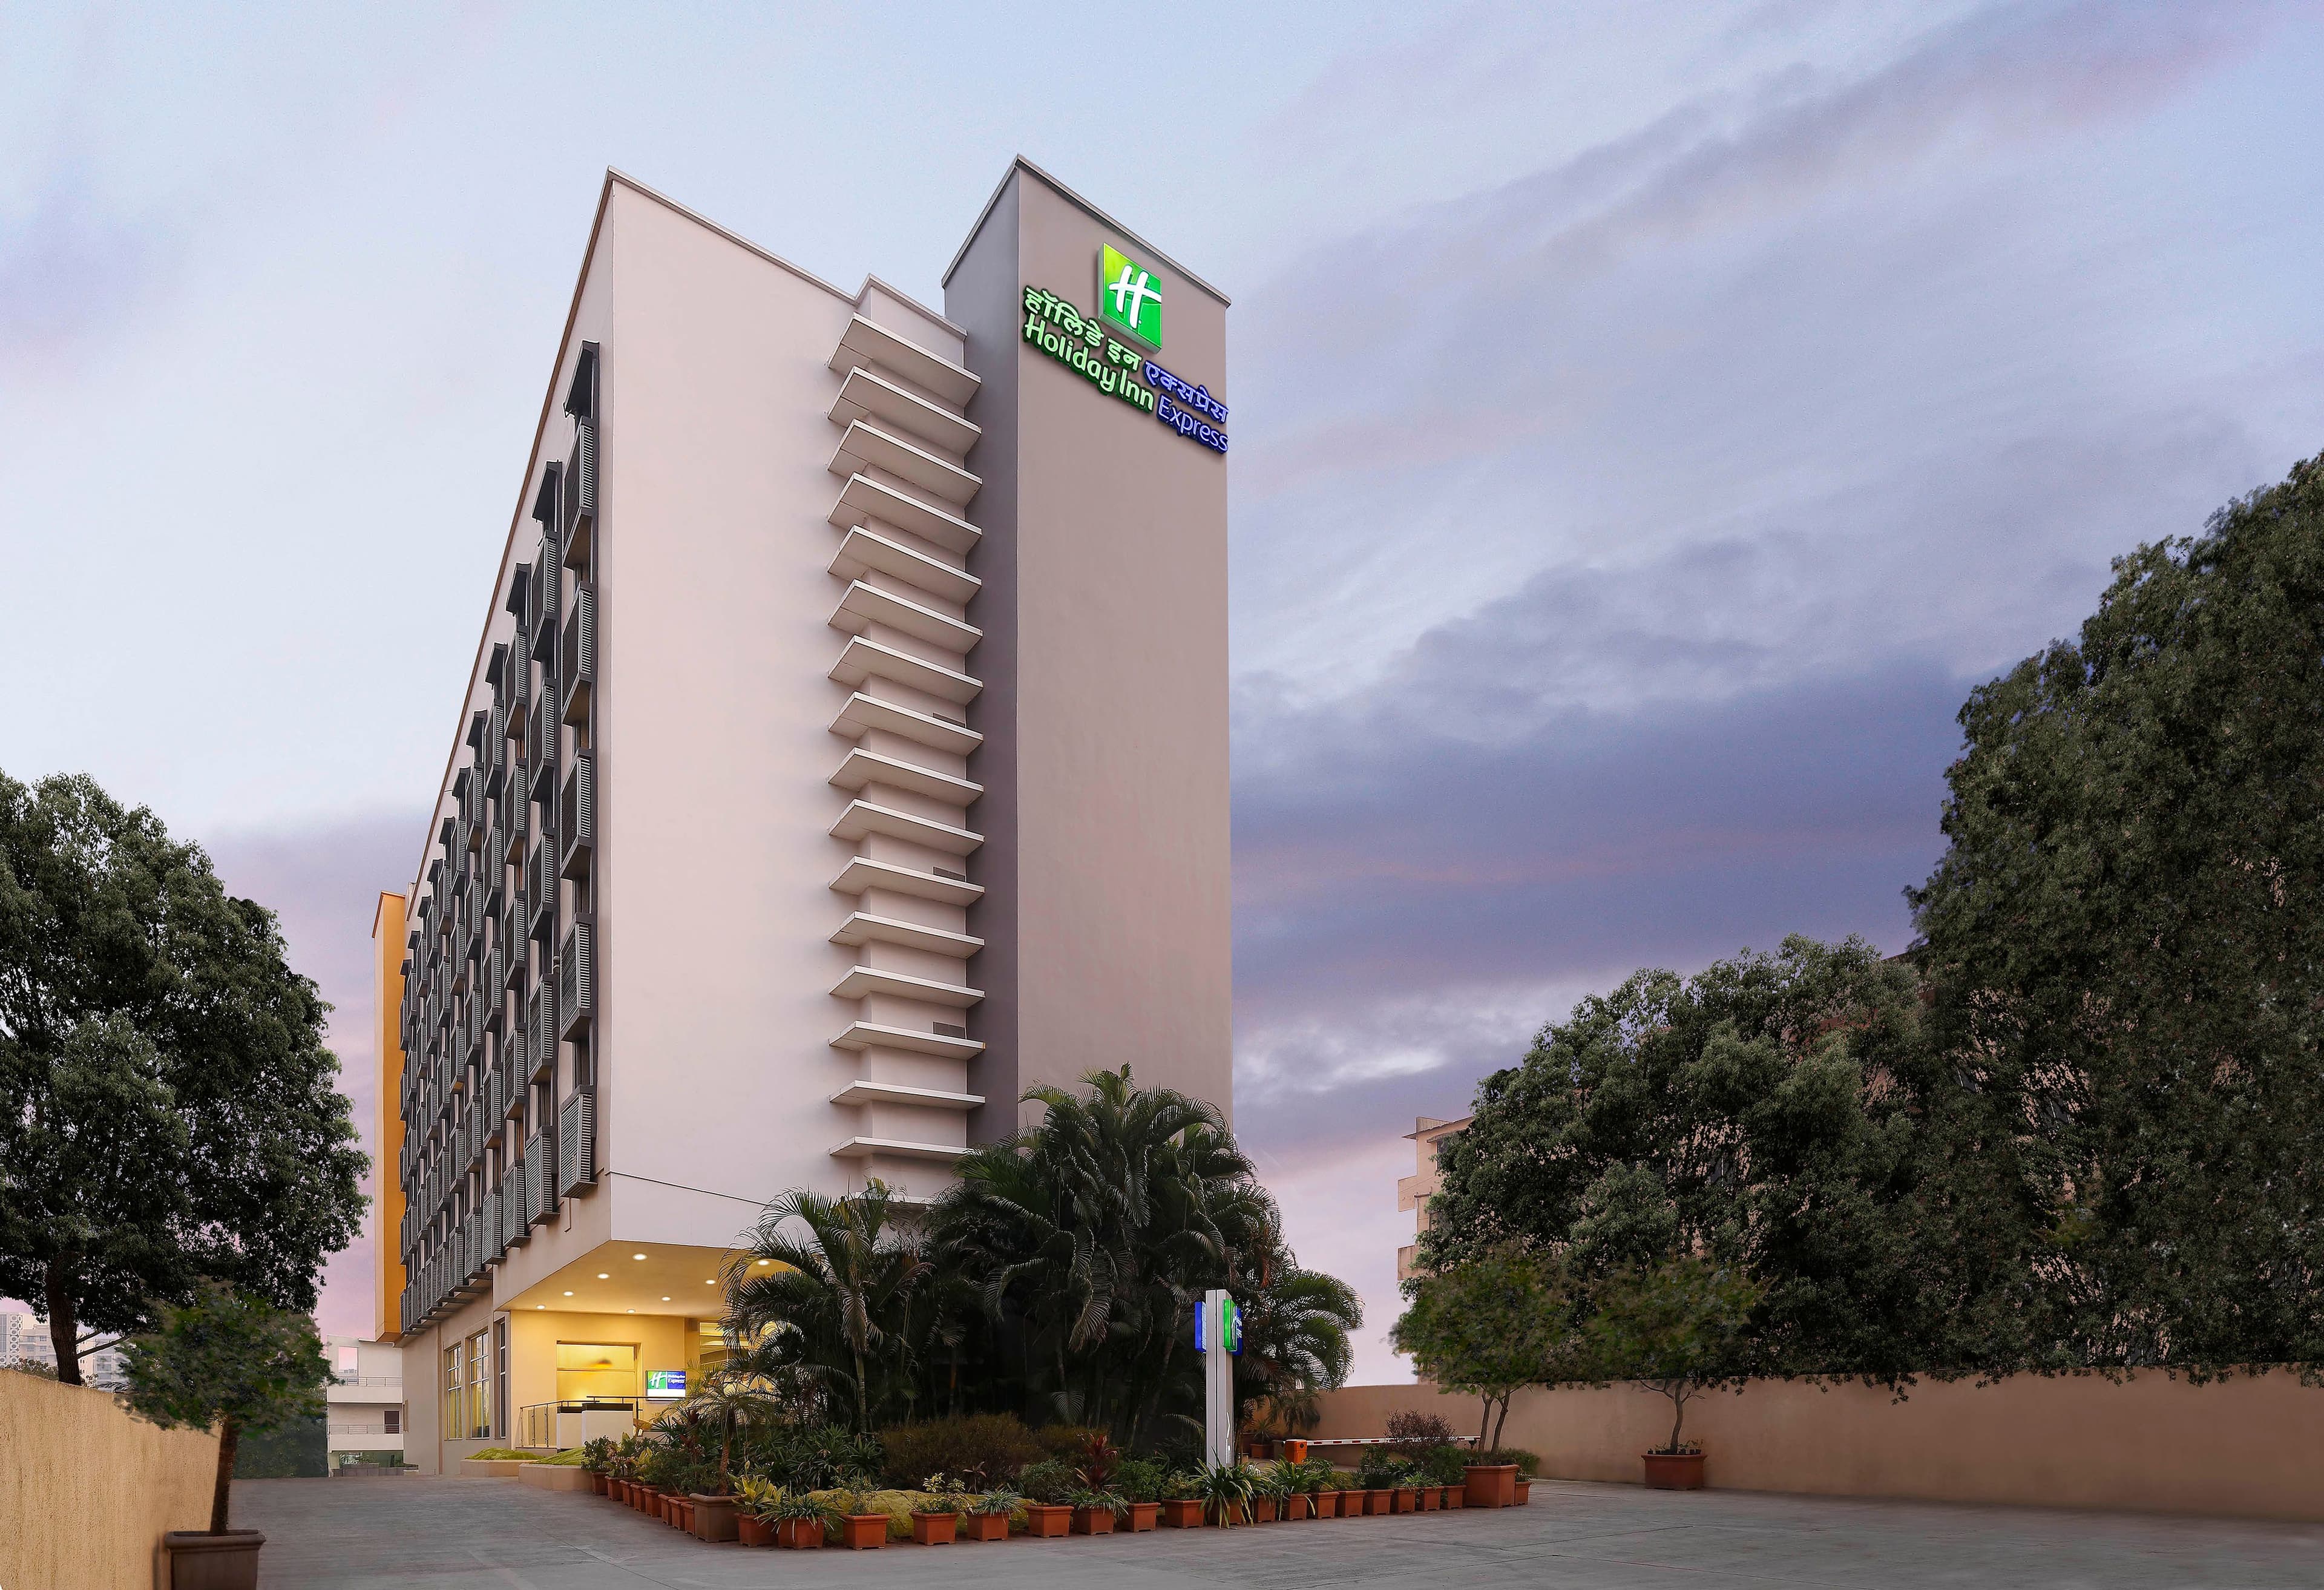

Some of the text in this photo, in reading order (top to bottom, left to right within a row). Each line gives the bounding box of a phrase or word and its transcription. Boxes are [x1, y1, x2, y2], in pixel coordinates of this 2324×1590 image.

[1024, 286, 1105, 347] हॉलिडे
[1107, 338, 1143, 371] इन
[1024, 314, 1229, 452] Holiday Inn Express
